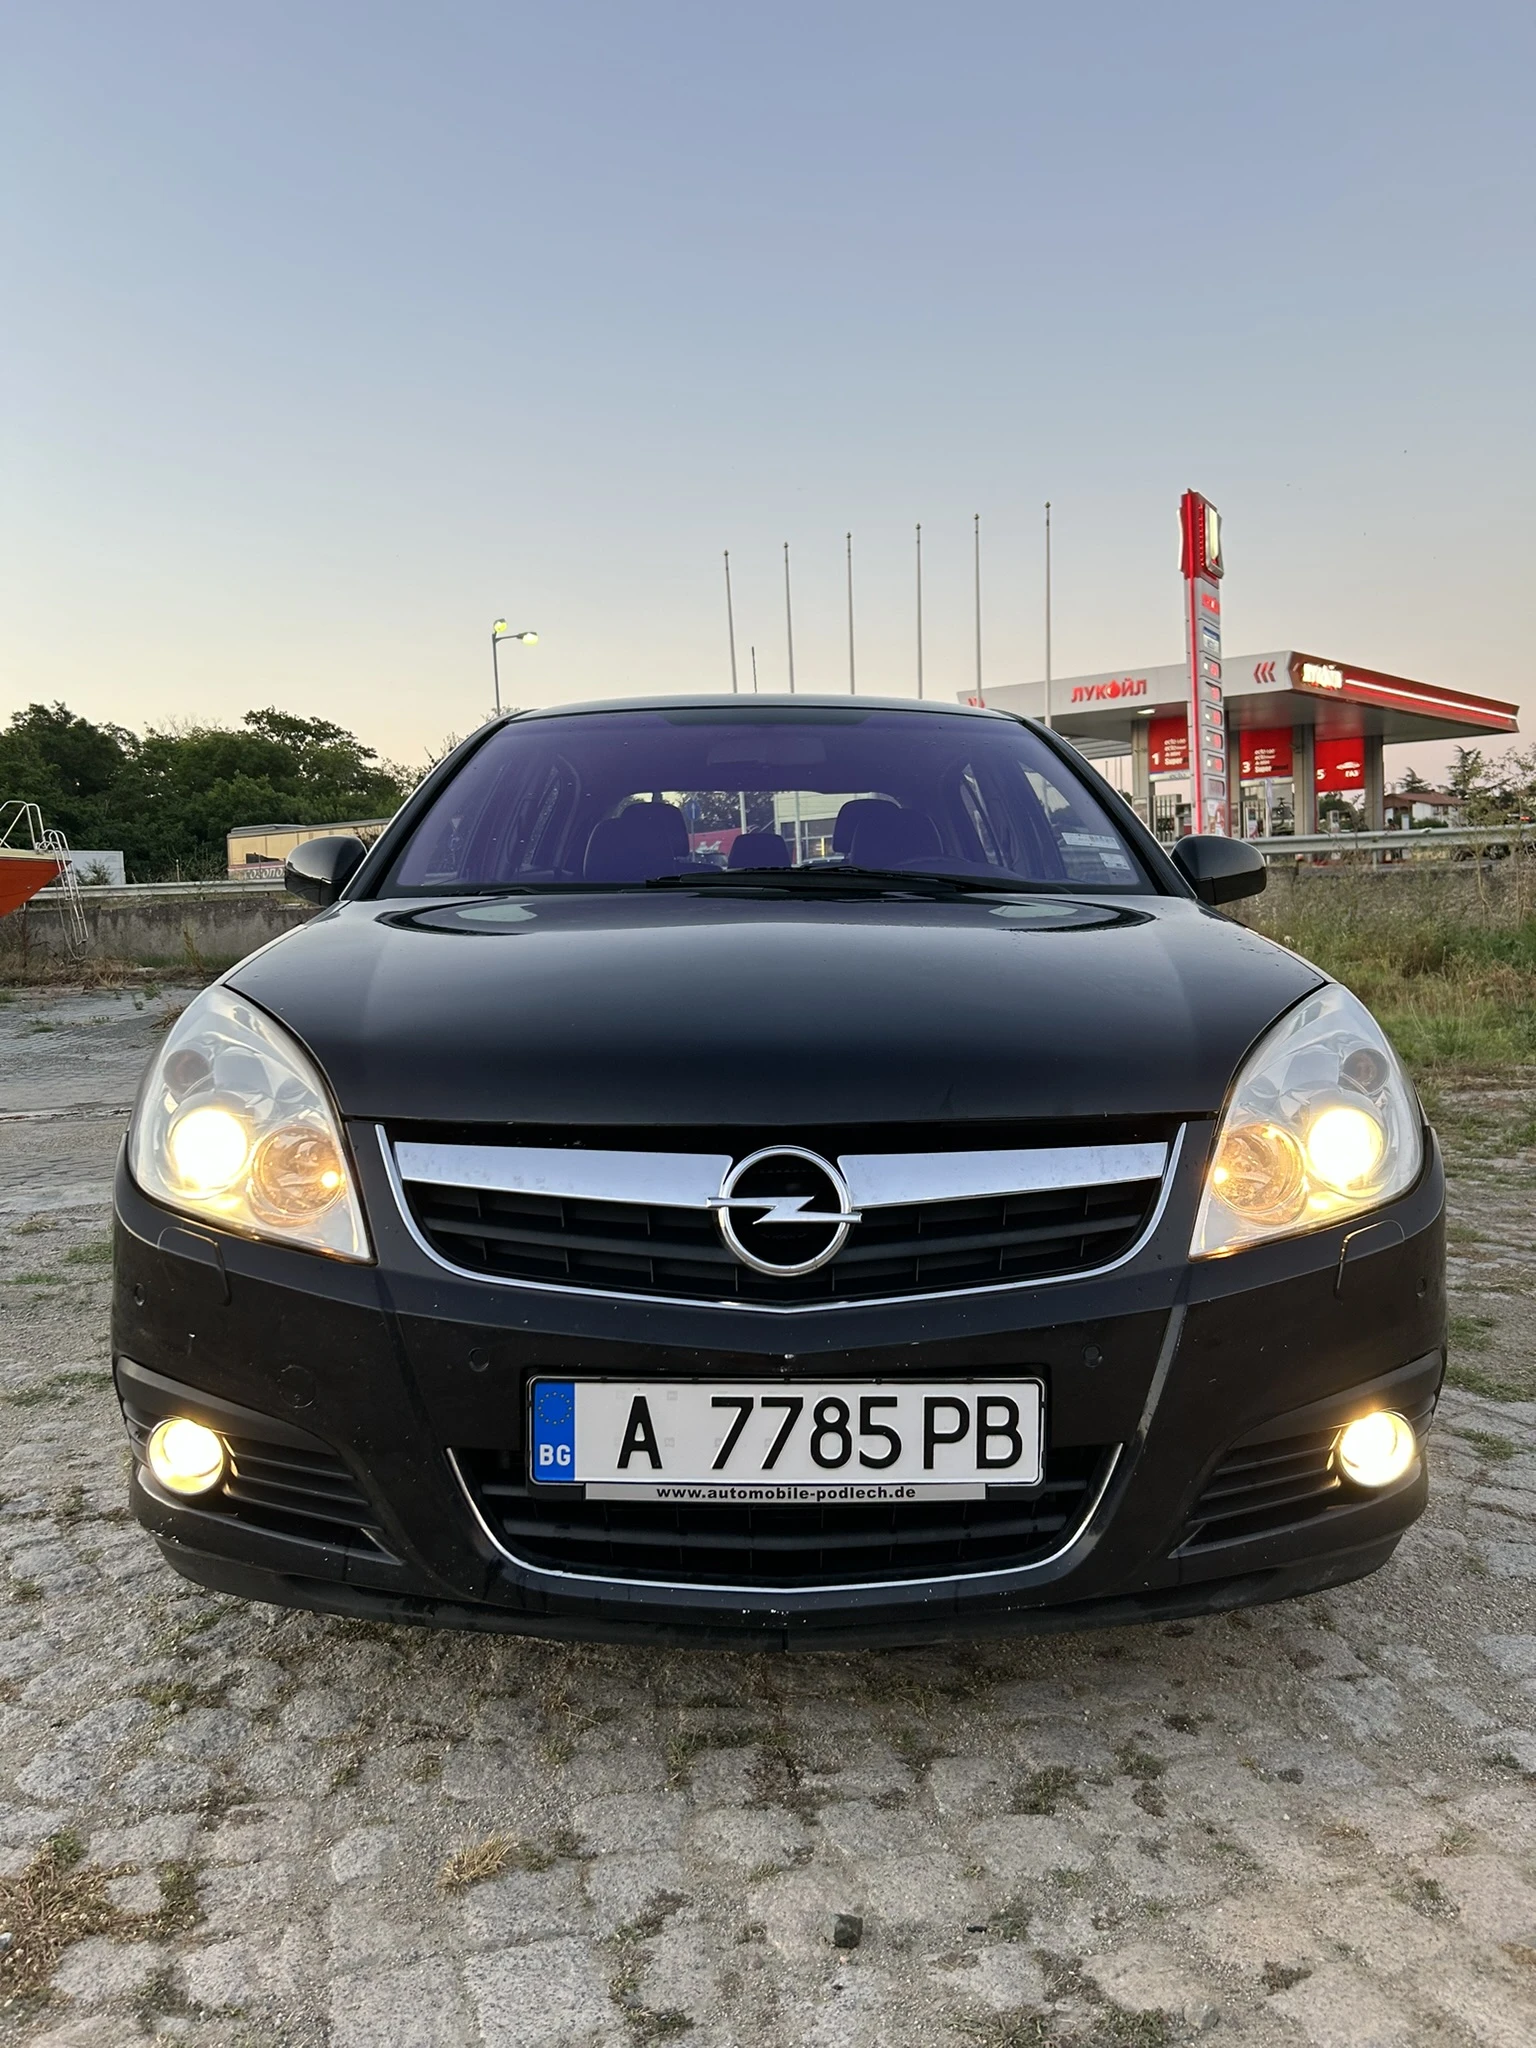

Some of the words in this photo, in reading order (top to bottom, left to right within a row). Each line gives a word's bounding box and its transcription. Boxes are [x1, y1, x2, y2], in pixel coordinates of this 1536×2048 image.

[1151, 752, 1160, 765] 1
[1242, 761, 1251, 773] 3
[1316, 768, 1326, 780] 5
[616, 1395, 663, 1470] A
[539, 1443, 571, 1467] BG
[656, 1486, 916, 1502] www.automobile-podlech.de
